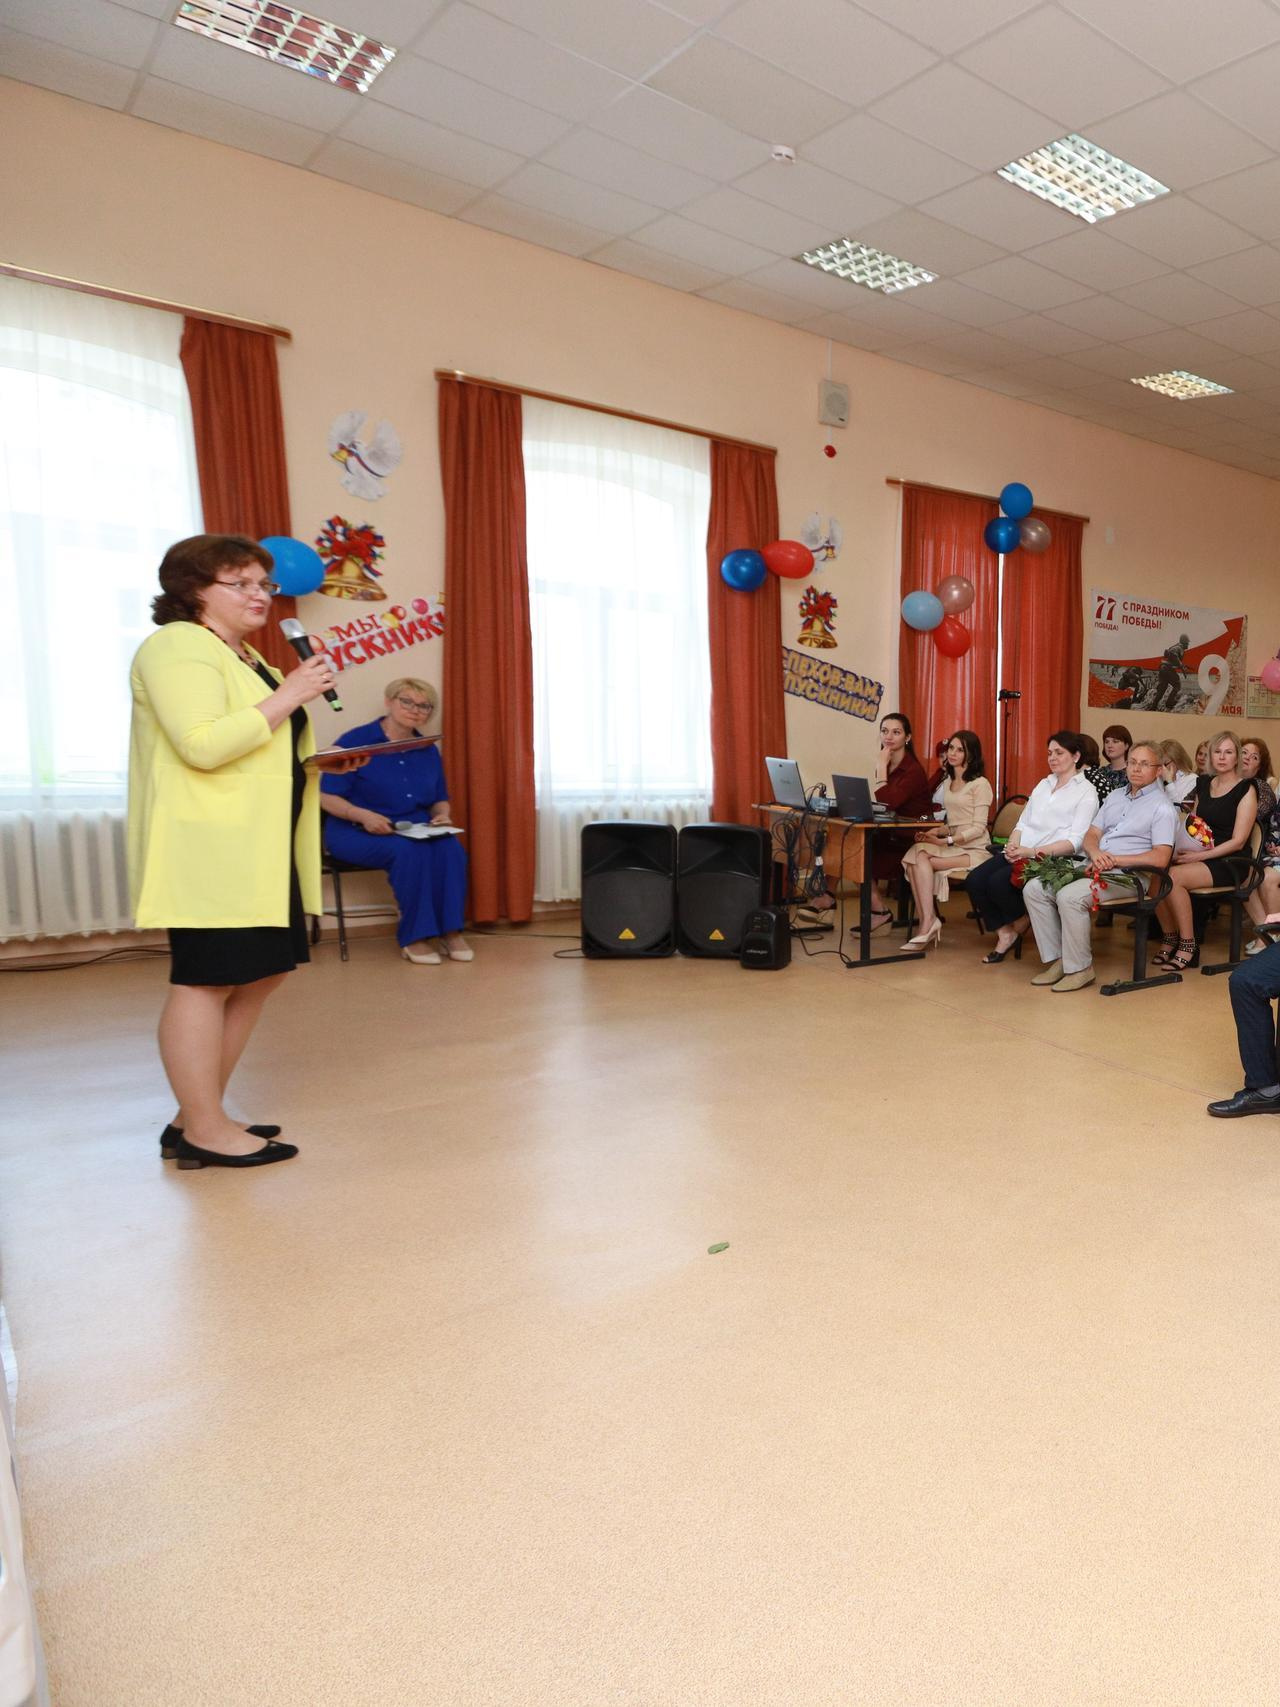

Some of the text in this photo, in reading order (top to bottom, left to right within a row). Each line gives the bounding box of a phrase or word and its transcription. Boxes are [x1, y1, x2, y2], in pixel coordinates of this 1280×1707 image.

[1095, 595, 1117, 620] 77
[1122, 601, 1190, 620] С ПРАЗДНИКОМ
[328, 613, 382, 642] МЫ
[1121, 614, 1162, 630] ПОБЕДЫ!
[321, 610, 446, 672] УСКНИК
[1198, 653, 1230, 715] 9
